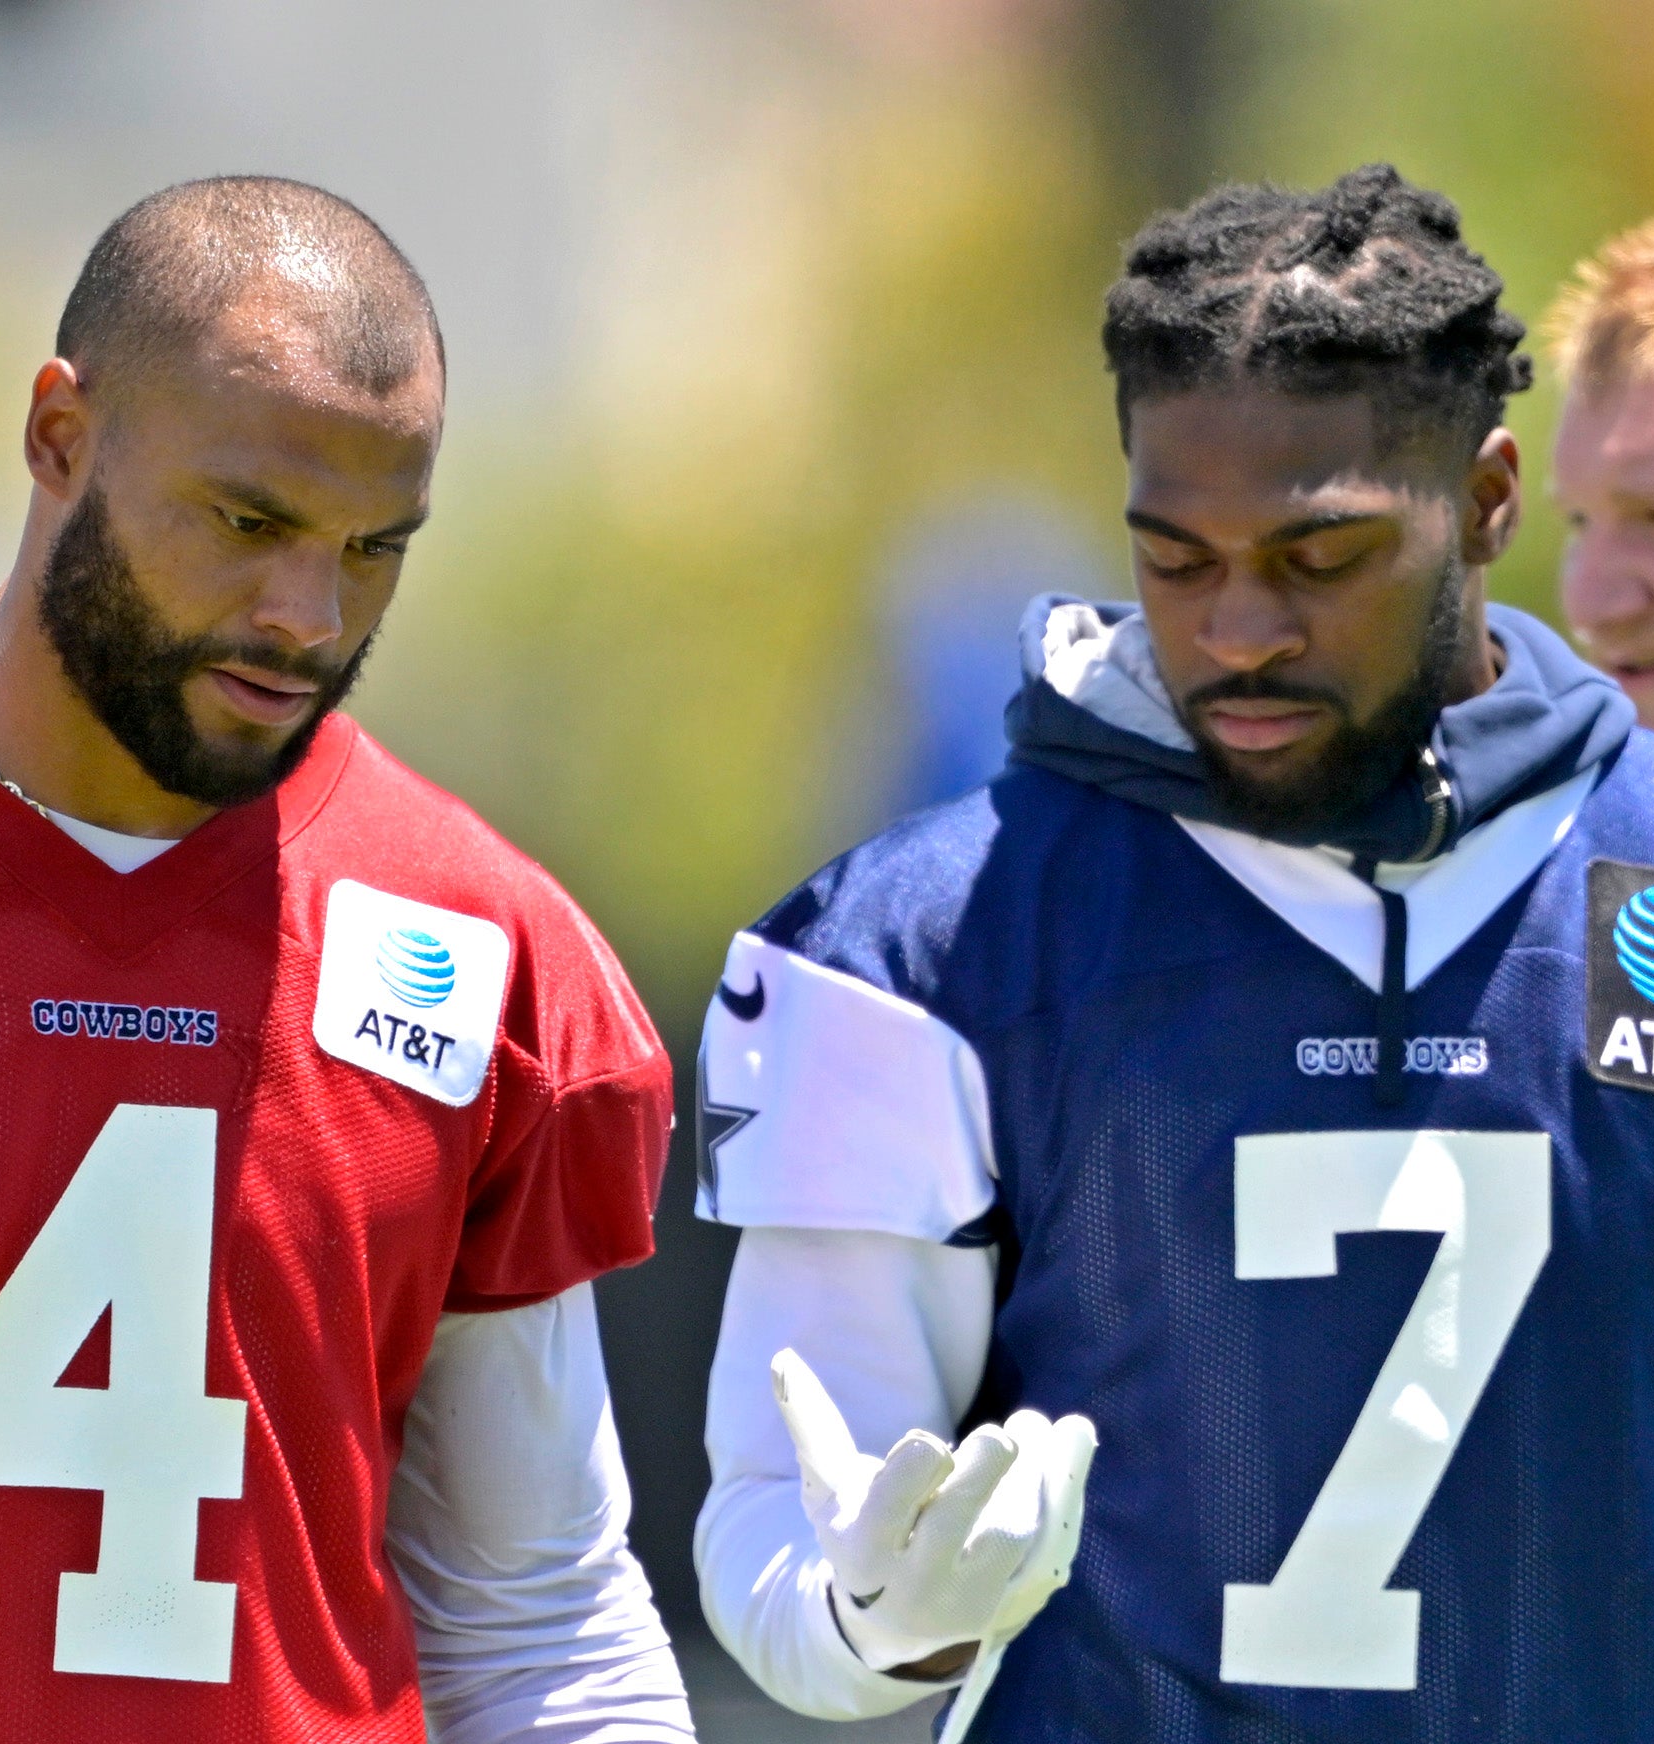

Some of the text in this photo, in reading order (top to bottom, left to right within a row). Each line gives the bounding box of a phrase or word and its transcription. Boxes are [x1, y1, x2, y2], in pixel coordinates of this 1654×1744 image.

[31, 999, 217, 1046] COWBOYS
[355, 1007, 456, 1072] AT&T
[1297, 1037, 1489, 1075] COWOYS
[1220, 1130, 1552, 1690] 7
